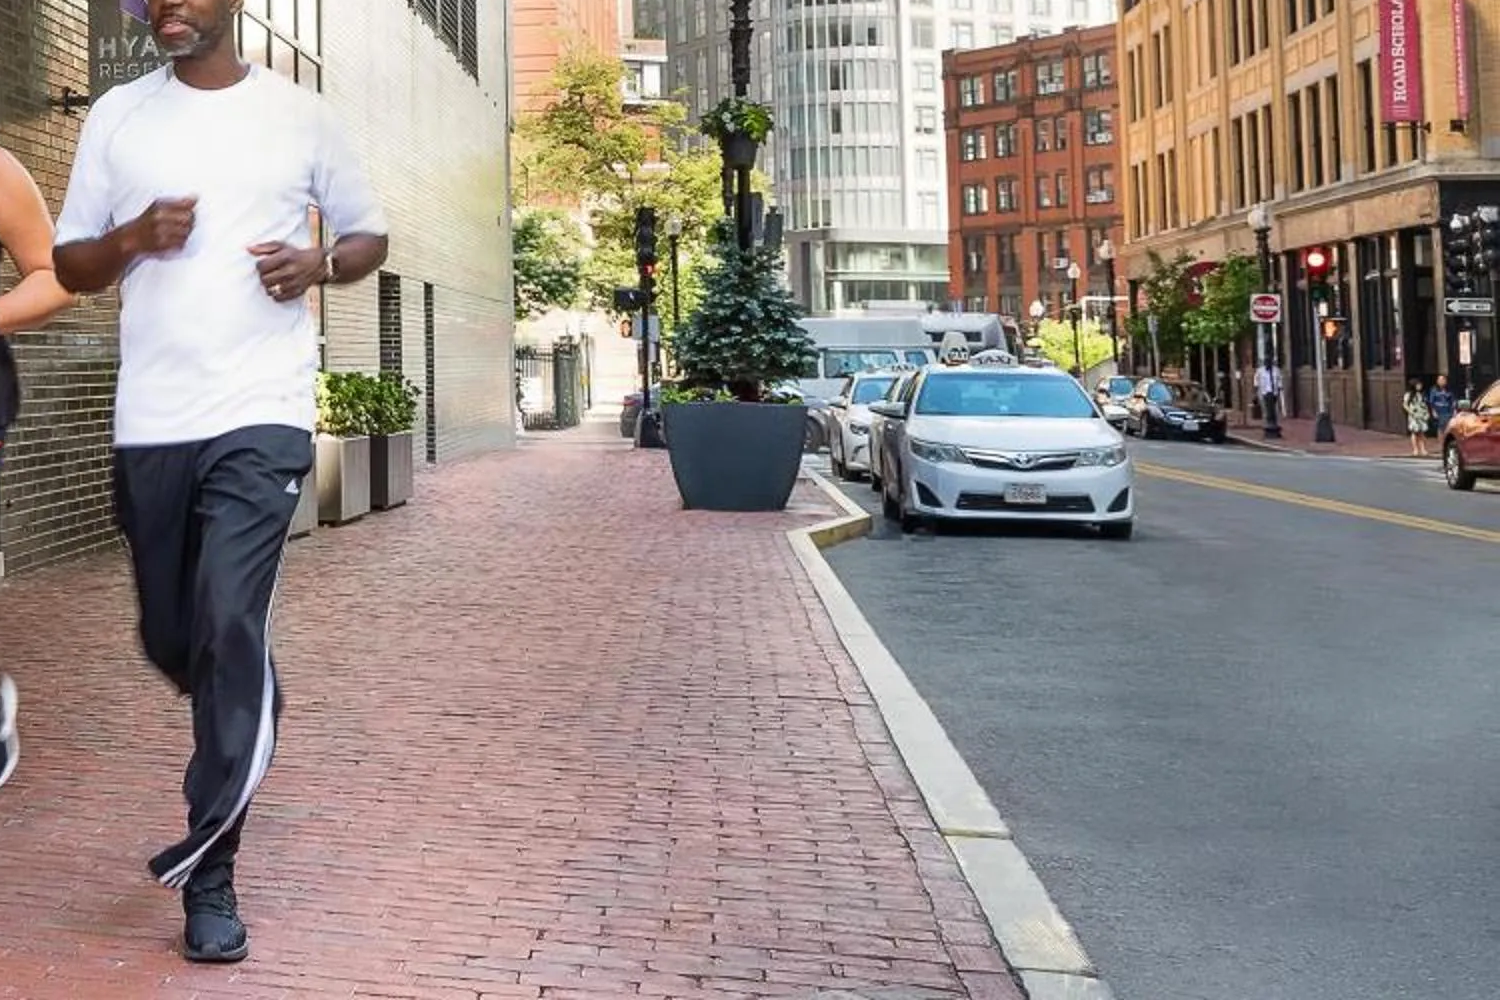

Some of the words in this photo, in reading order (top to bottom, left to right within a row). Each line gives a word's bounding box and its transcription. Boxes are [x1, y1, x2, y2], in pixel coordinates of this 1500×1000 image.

[98, 35, 160, 58] HYA
[98, 61, 156, 79] REGE
[1392, 58, 1407, 102] ROAD
[978, 354, 1012, 365] TAXI
